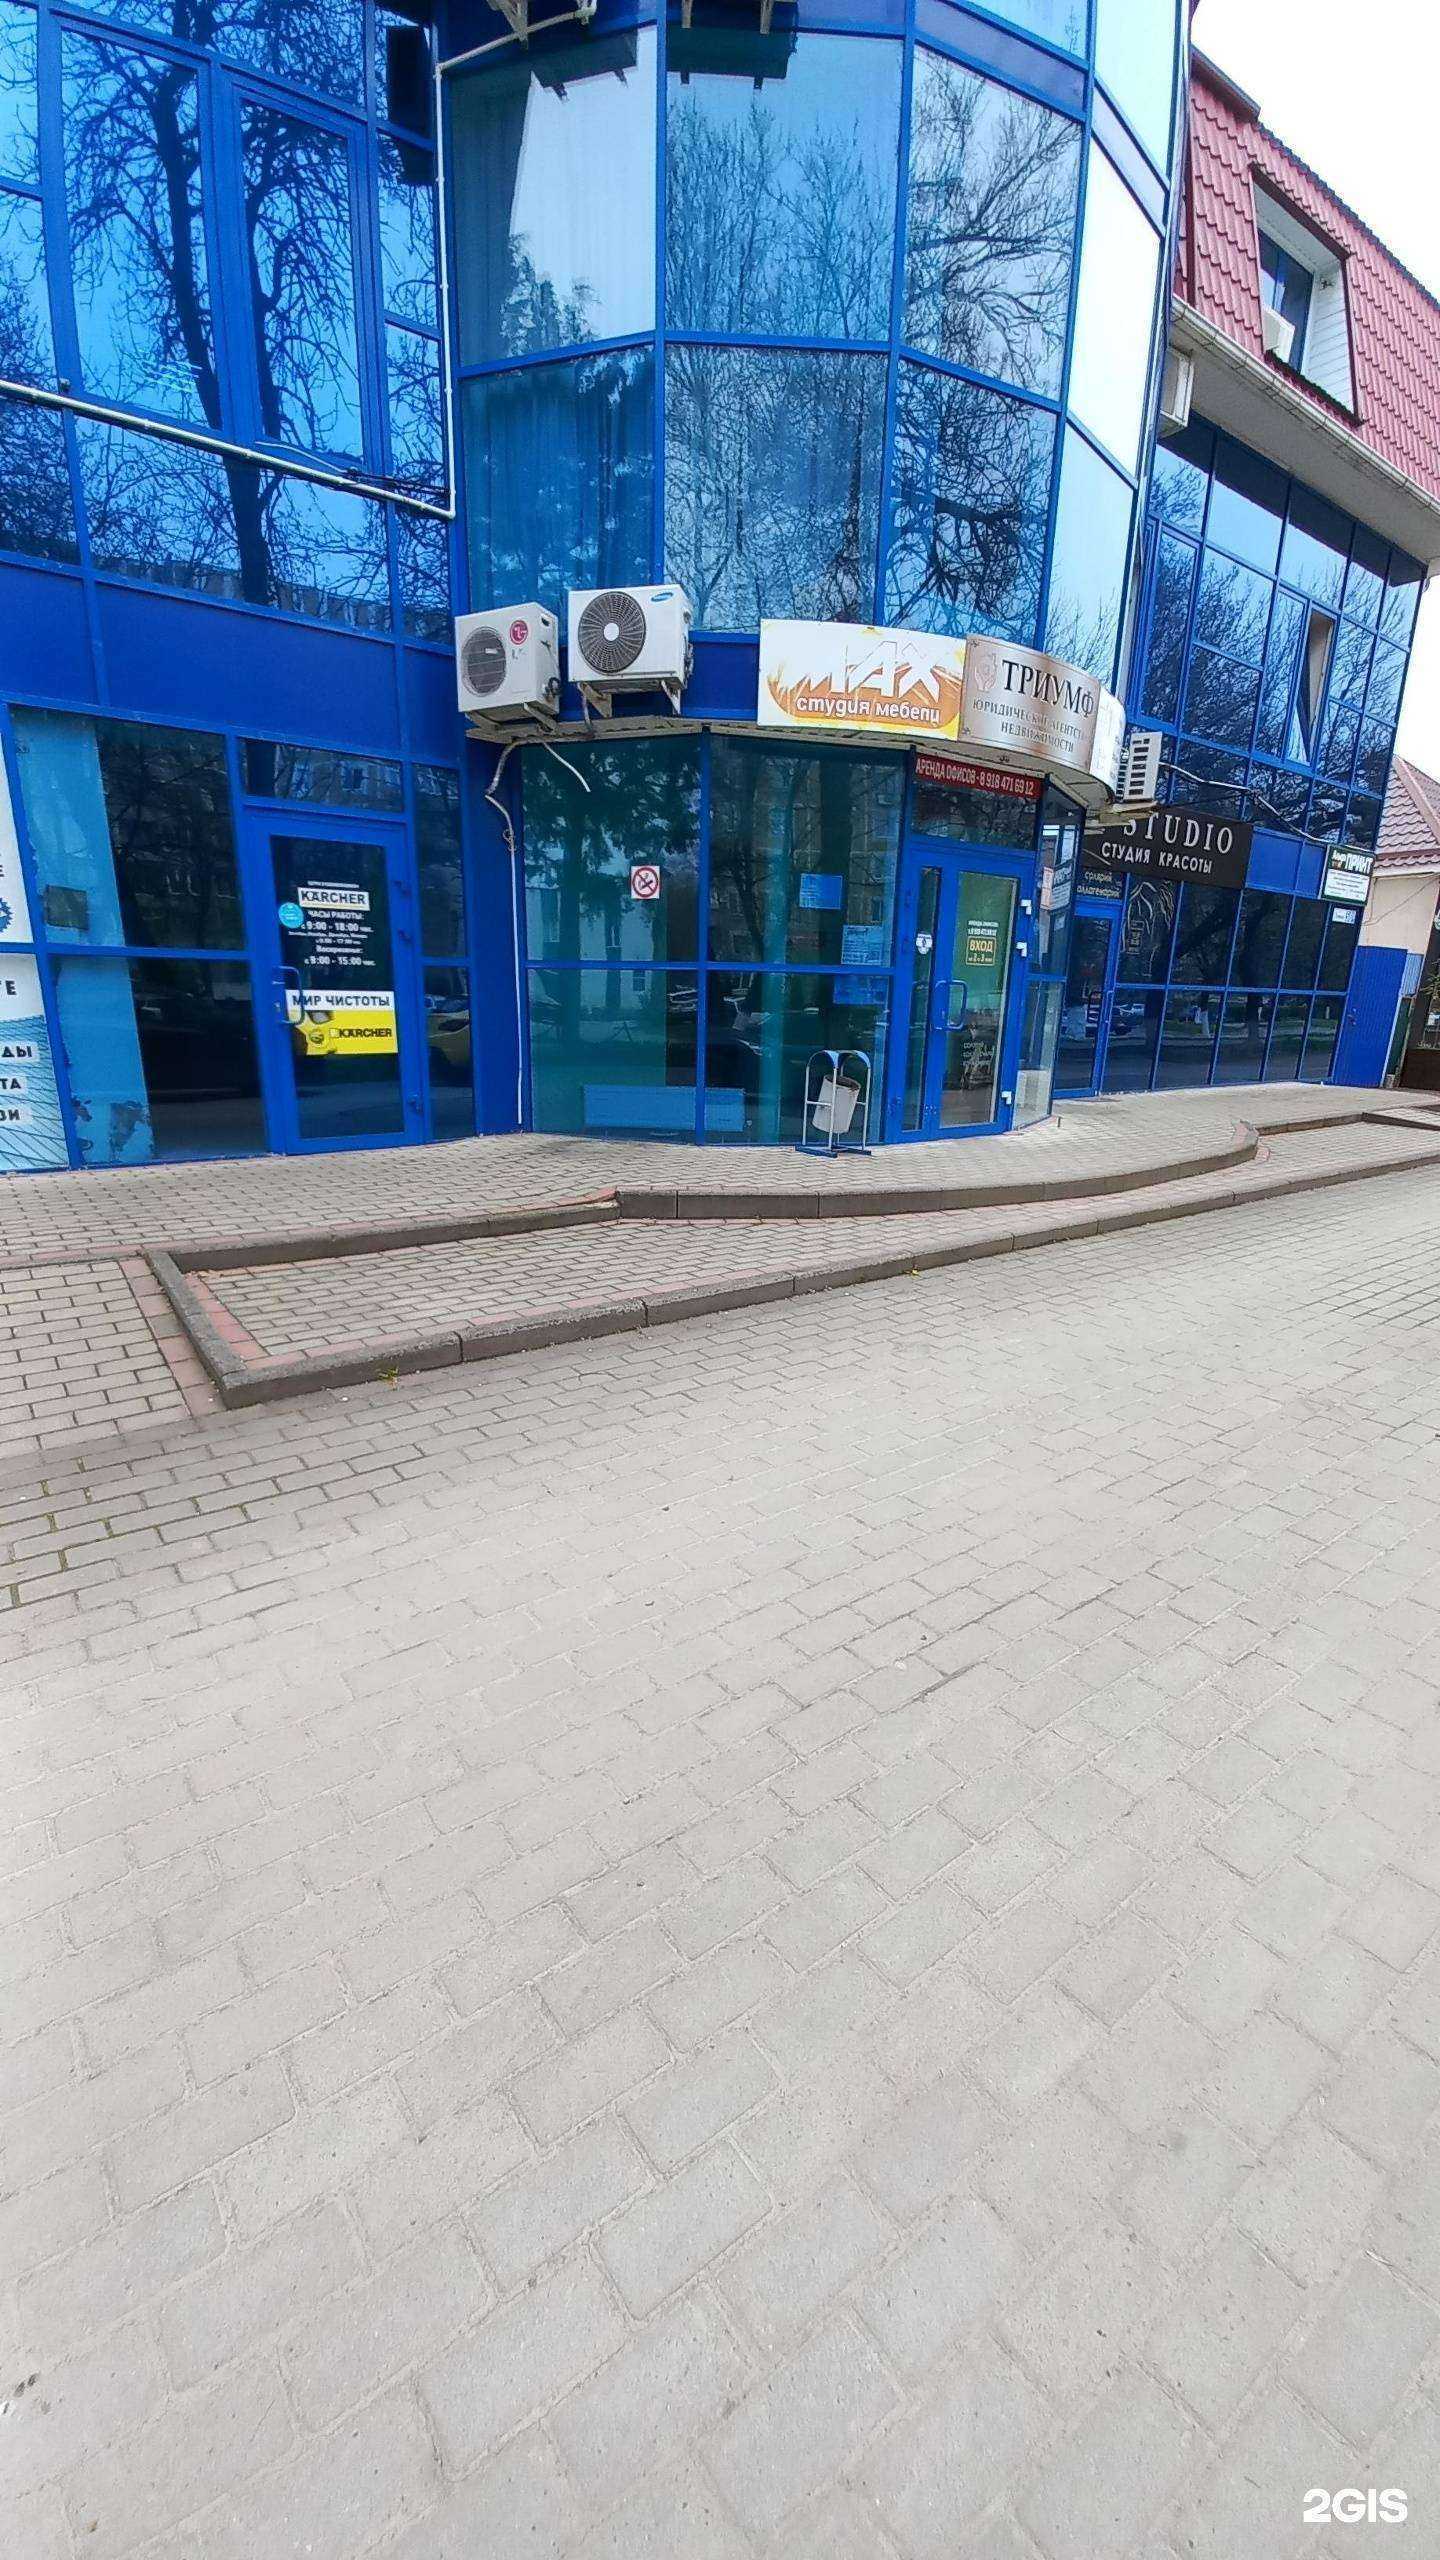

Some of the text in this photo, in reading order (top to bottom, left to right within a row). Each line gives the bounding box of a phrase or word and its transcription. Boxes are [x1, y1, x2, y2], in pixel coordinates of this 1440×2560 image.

[796, 695, 870, 719] студия
[1002, 659, 1095, 721] ТРИУМФ
[915, 758, 945, 780] АРЕНДА
[946, 764, 976, 784] ОФИСОВ
[1000, 776, 1014, 793] 471
[1124, 810, 1234, 854] STUDIO
[1101, 841, 1213, 875] СТУДИЯ КРАСОТЫ
[969, 939, 993, 953] ВХОД
[292, 995, 390, 1007] МИР ЧИСТОТЫ
